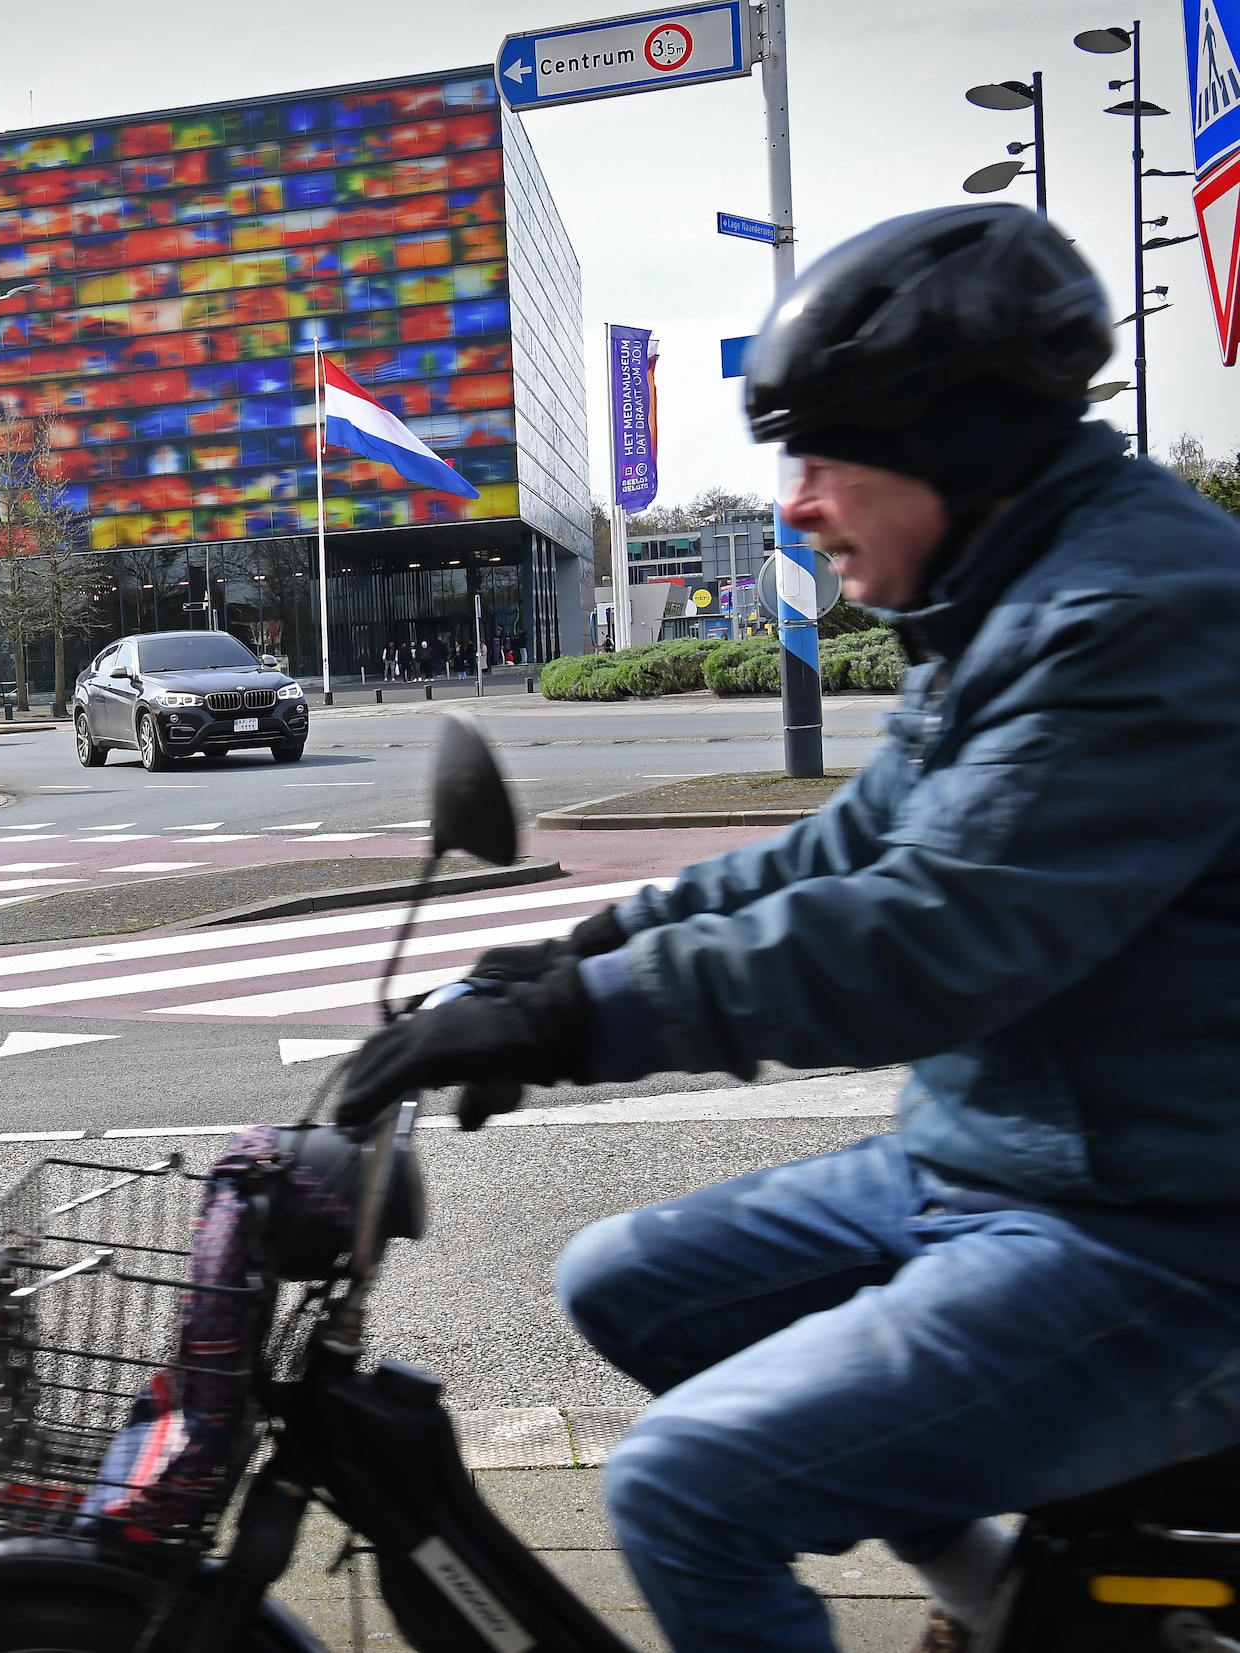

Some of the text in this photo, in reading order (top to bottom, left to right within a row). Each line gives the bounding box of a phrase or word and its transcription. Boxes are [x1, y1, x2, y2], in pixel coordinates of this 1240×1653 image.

[540, 48, 635, 76] Centrum
[727, 218, 774, 239] Lage Naarderweg
[621, 340, 633, 456] HET MEDIAMUSEUM
[632, 340, 646, 455] DAT DRAAIT OM JOU
